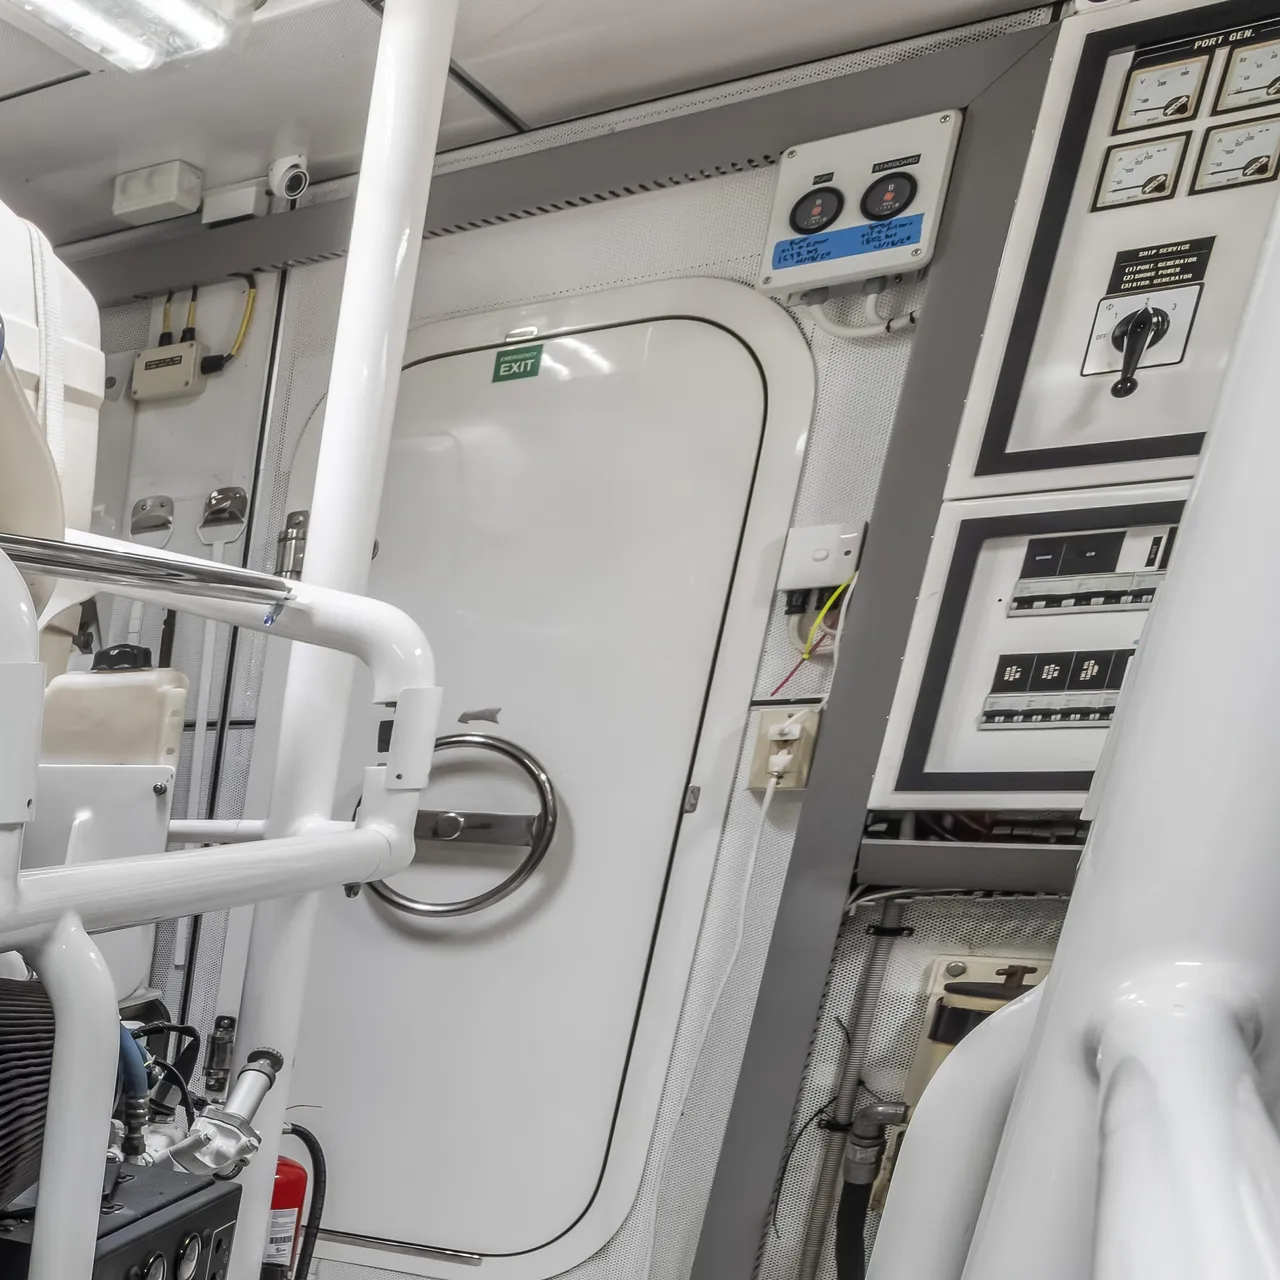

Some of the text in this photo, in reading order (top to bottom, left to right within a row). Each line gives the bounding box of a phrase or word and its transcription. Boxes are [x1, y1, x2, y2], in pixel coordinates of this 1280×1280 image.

[1194, 29, 1256, 49] PORT GEN.
[873, 156, 920, 172] STARBOARD
[1138, 243, 1191, 257] SHIP SERVICE
[1158, 257, 1197, 267] GENERATOR
[1158, 267, 1181, 275] POWER
[1153, 273, 1192, 284] GENERATOR
[499, 359, 535, 376] EXIT
